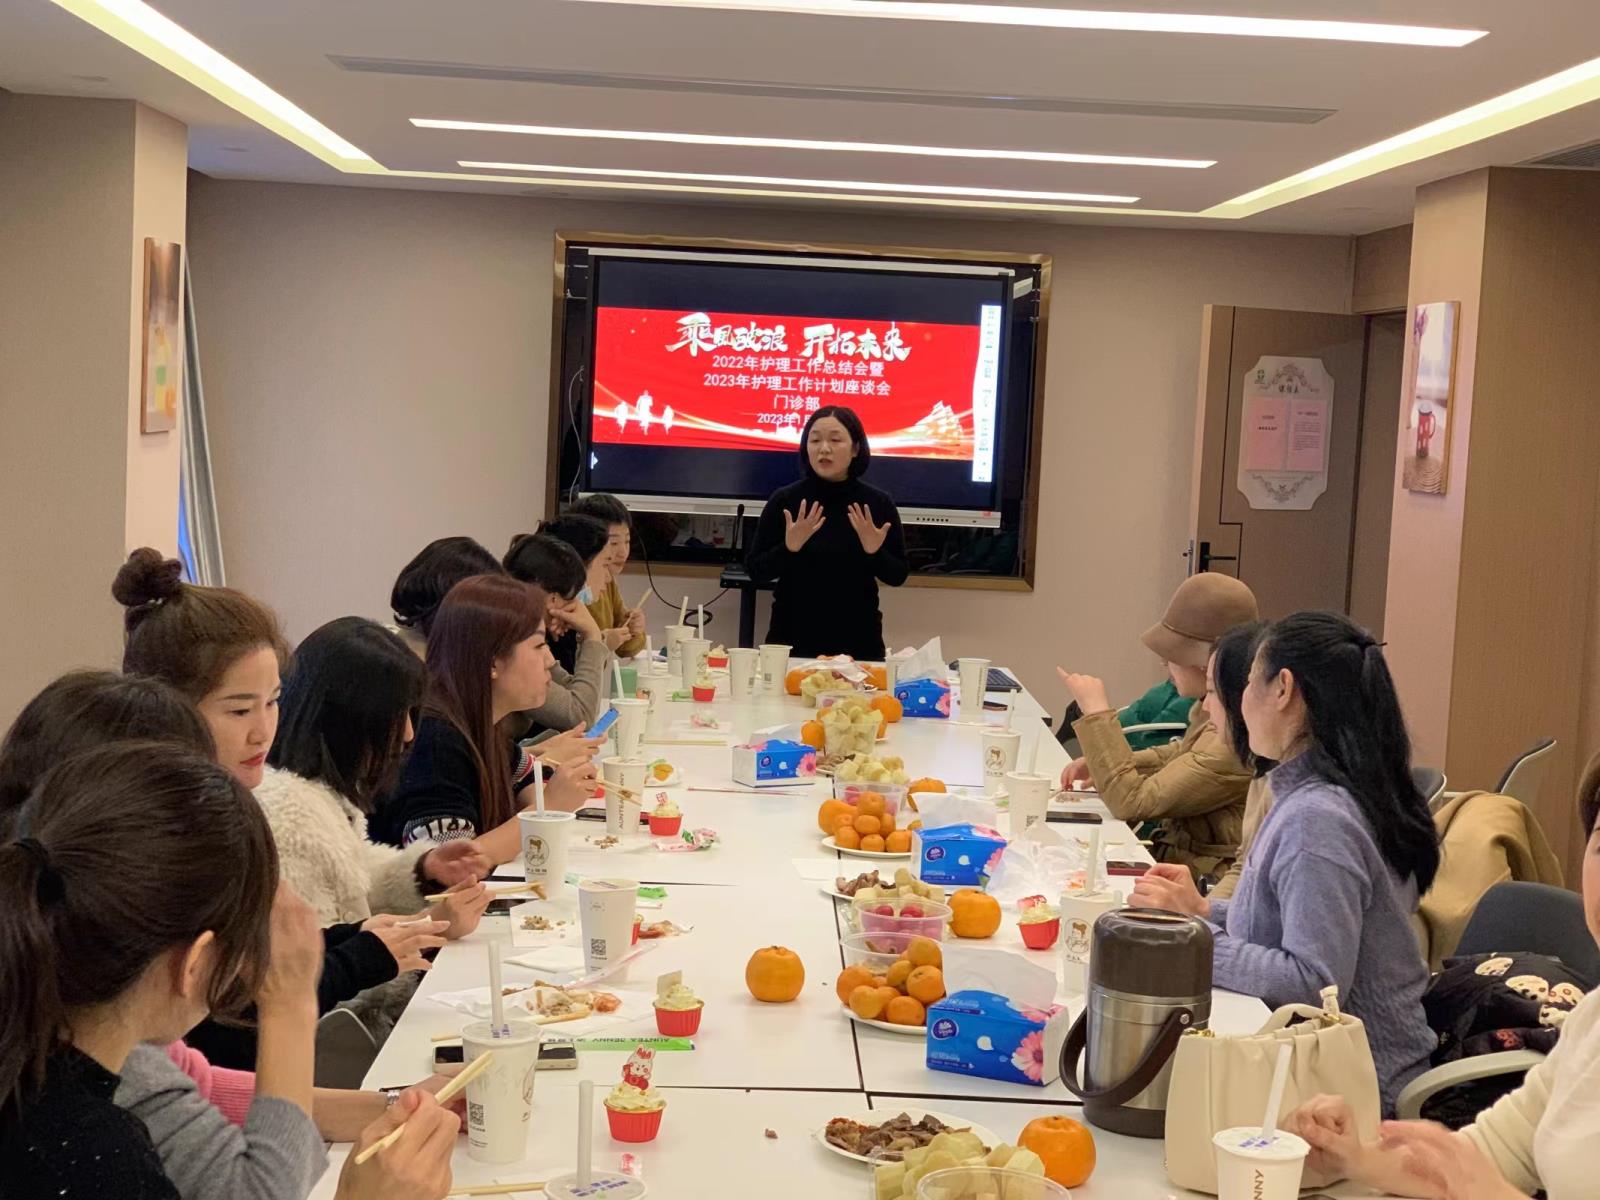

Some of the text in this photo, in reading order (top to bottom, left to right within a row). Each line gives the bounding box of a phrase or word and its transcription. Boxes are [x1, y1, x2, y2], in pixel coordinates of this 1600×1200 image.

[800, 322, 912, 363] 开拓未来
[712, 355, 885, 377] 2022年护理工作总结会暨
[703, 373, 892, 396] 2023年护理工作计划座谈会
[773, 394, 820, 411] 门诊部
